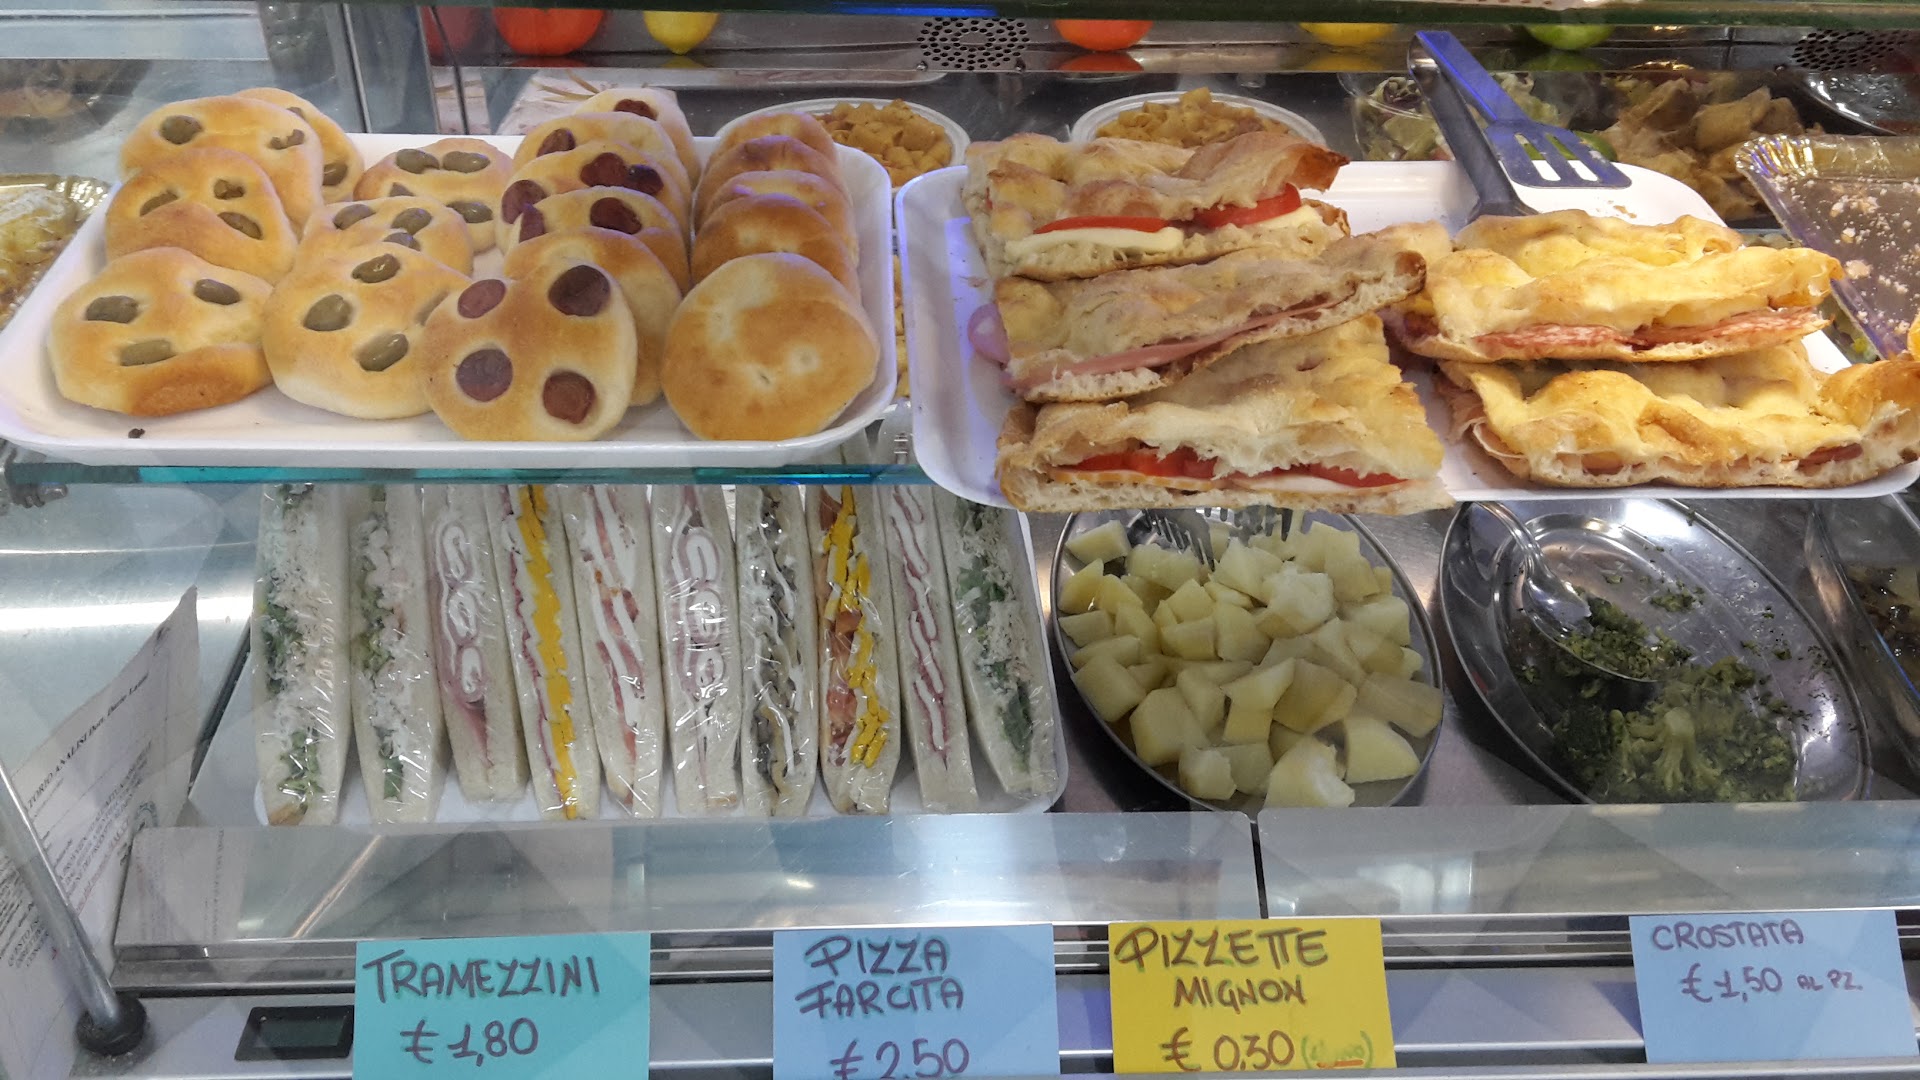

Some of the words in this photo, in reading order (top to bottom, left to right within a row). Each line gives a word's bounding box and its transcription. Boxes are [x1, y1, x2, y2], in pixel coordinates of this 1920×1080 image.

[1114, 926, 1329, 971] PIZZETTE
[1652, 918, 1805, 951] CROSTATA
[362, 949, 600, 1003] TRAMEZZINI
[804, 935, 948, 976] PIZZA
[795, 976, 964, 1018] FARCITA
[1173, 975, 1307, 1014] MIGNON
